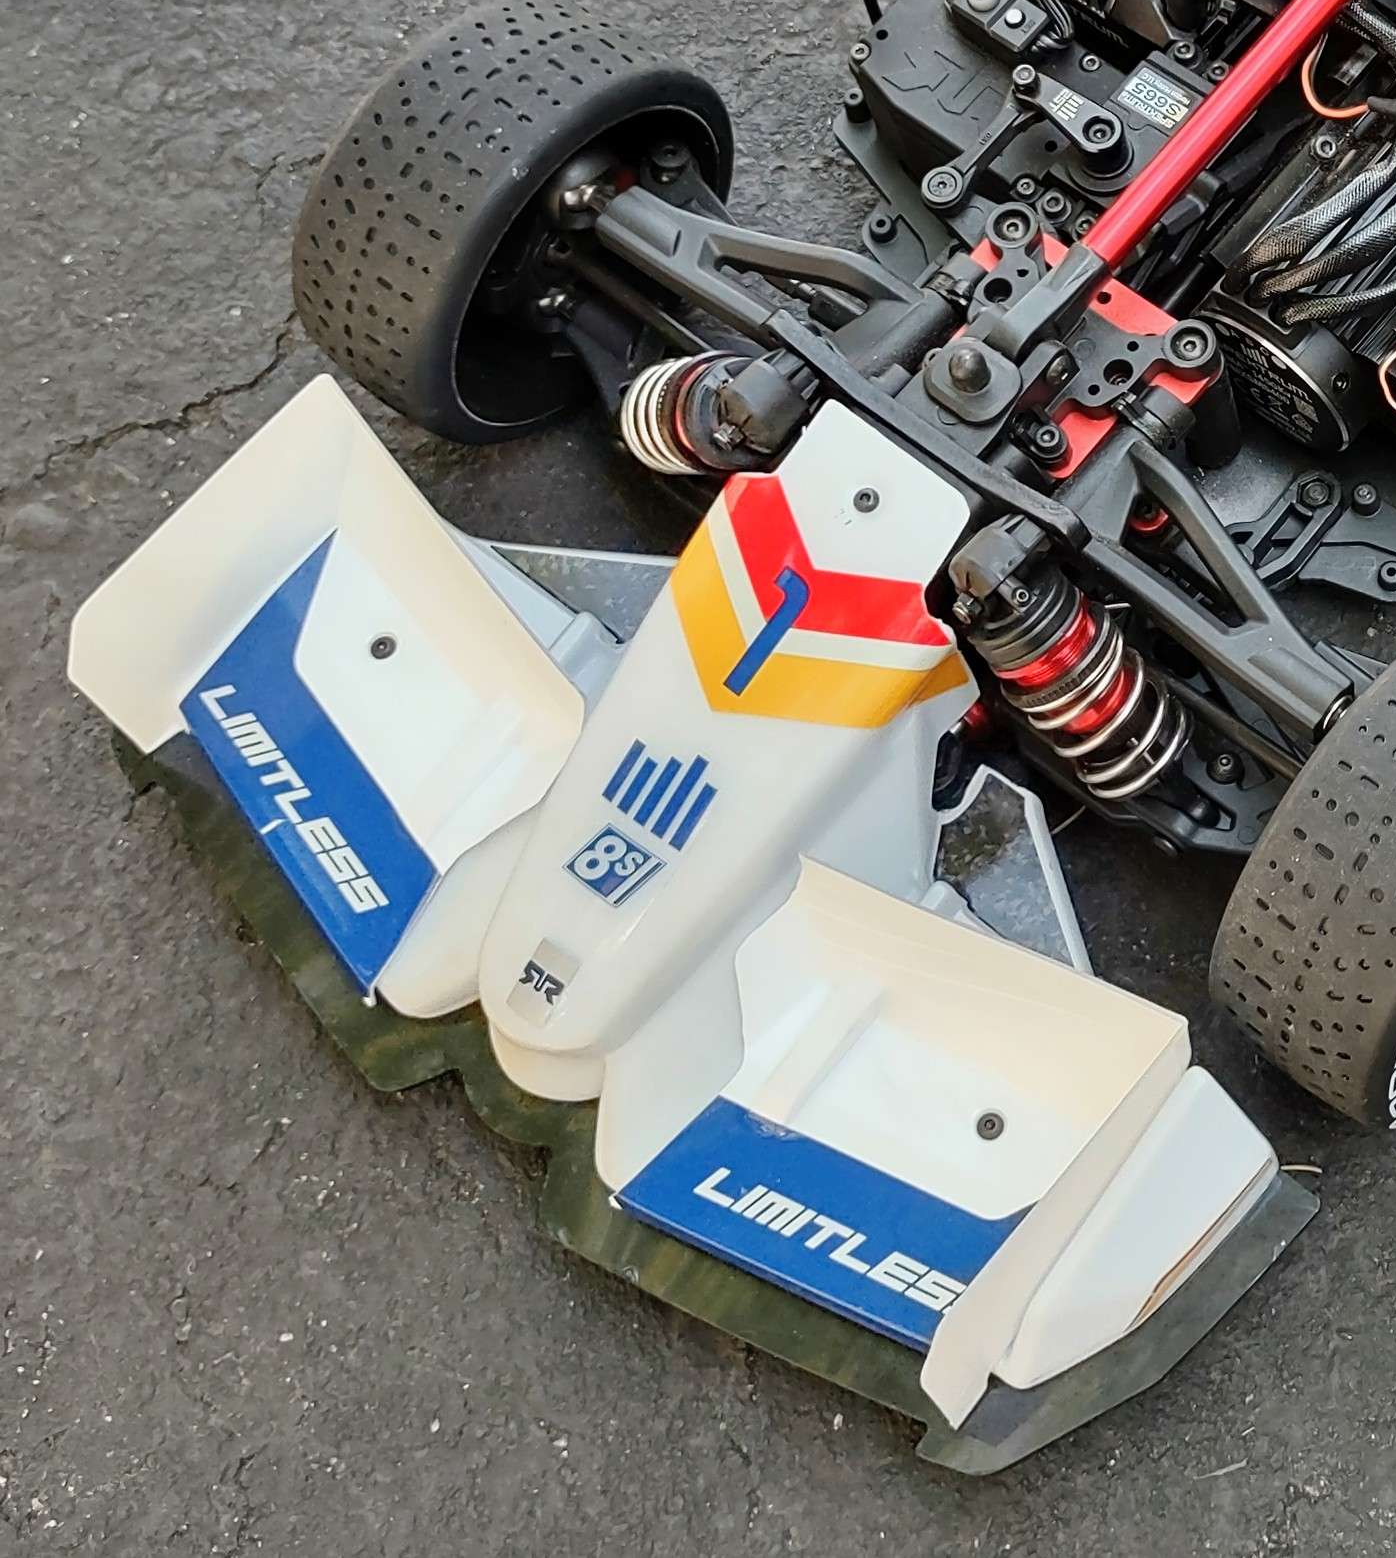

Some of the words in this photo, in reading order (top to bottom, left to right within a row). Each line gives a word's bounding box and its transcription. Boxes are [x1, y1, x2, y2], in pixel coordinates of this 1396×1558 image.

[1131, 82, 1182, 116] S665
[199, 684, 389, 914] LIMITLESS
[692, 1166, 967, 1315] LIMITLES
